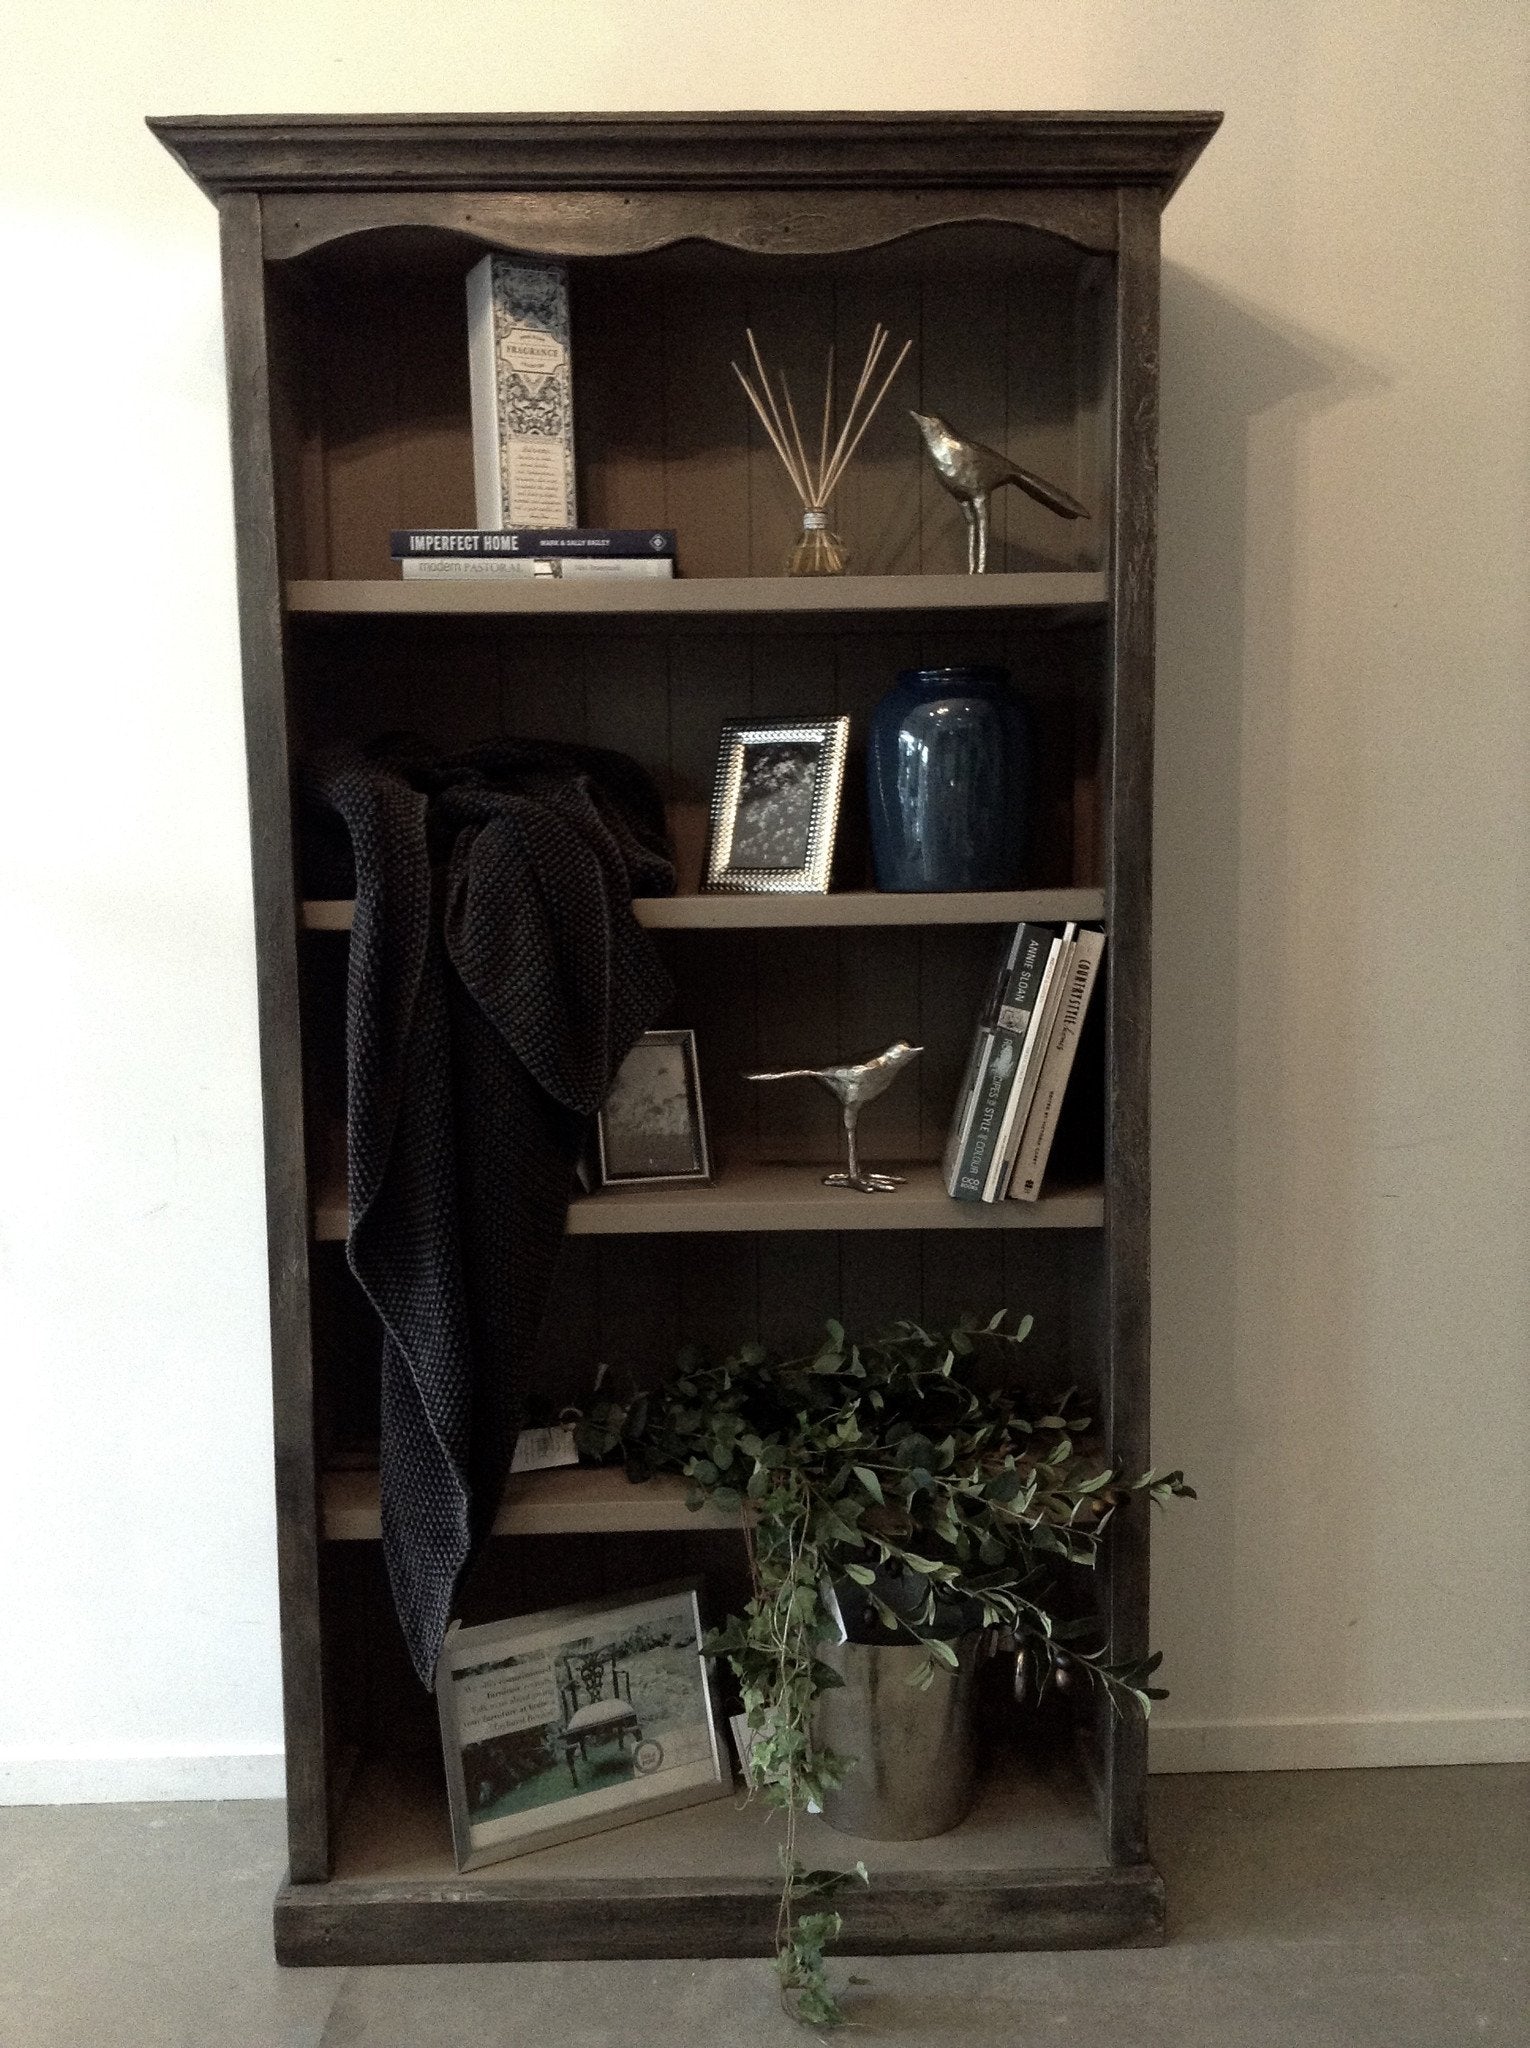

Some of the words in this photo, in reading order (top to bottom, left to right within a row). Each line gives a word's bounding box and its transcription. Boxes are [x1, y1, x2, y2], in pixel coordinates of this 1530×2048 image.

[506, 345, 559, 358] FRAGRANCE
[409, 535, 480, 551] IMPERFECT
[483, 535, 520, 551] HOME
[419, 562, 462, 573] modern
[1024, 939, 1040, 970] ANNIE
[1014, 970, 1032, 1002] SLOAN
[980, 1107, 996, 1134] STYLE
[969, 1141, 987, 1174] COLOUR
